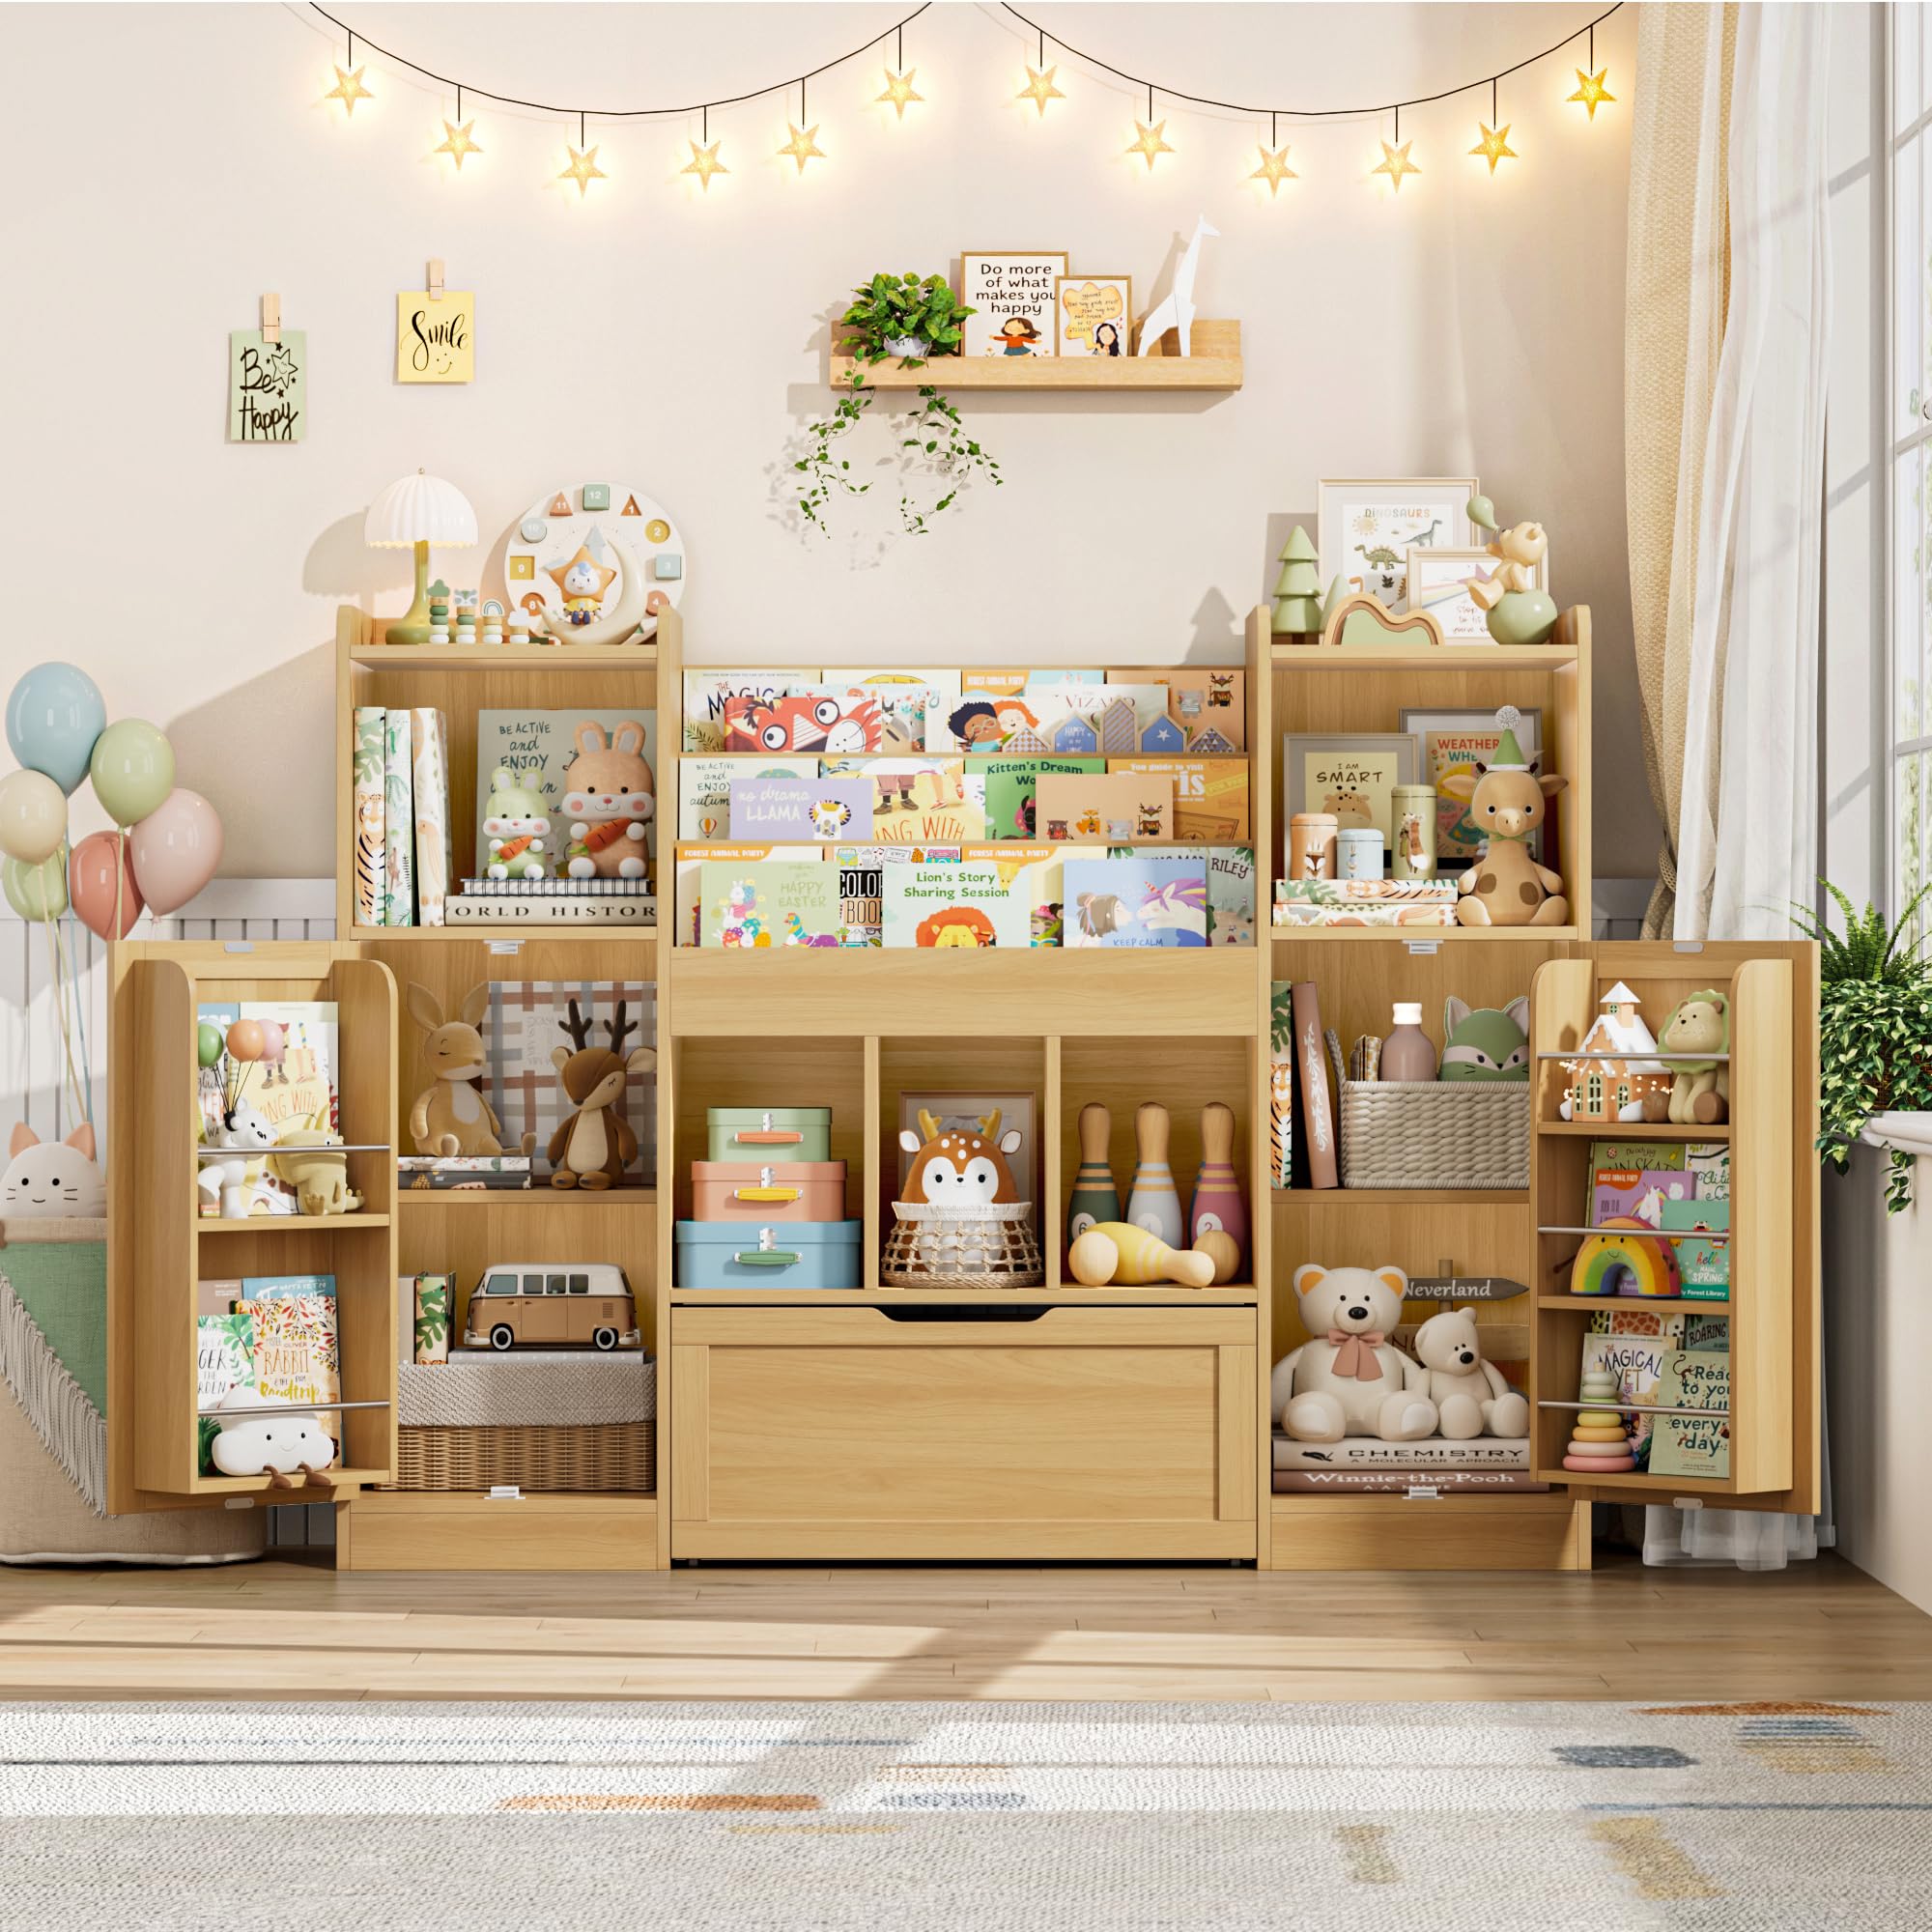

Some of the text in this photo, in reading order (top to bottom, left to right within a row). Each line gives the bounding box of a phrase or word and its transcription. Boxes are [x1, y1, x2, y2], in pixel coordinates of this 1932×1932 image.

[980, 264, 1052, 275] Do more
[985, 276, 1049, 288] of what
[976, 290, 1056, 302] makes you
[991, 302, 1042, 316] happy
[408, 310, 469, 372] Smile
[240, 346, 276, 394] Be
[238, 395, 298, 440] Happy
[588, 491, 602, 499] 12
[628, 504, 635, 514] 1
[653, 526, 662, 537] 2
[499, 721, 551, 734] BE ACTIVE
[510, 735, 539, 752] and
[1437, 739, 1499, 750] WEATHER
[500, 754, 549, 770] ENJOY
[987, 761, 1083, 775] Kitten's Dream
[1316, 772, 1383, 782] SMART
[760, 783, 810, 802] drama
[746, 806, 801, 820] LLAMA
[916, 871, 996, 884] Lion's Story
[781, 880, 824, 895] HAPPY
[903, 887, 1009, 900] Sharing Session
[779, 896, 827, 907] EASTER
[445, 907, 529, 917] ORLD
[1114, 938, 1163, 947] KEEP CALM
[1406, 1279, 1492, 1296] Neverland
[1689, 1322, 1726, 1346] ROARING
[264, 1348, 309, 1376] RABBIT
[1599, 1350, 1662, 1378] MAGICAL
[1614, 1367, 1643, 1391] YET
[1682, 1379, 1698, 1395] to
[1671, 1418, 1720, 1435] every
[1685, 1432, 1720, 1457] day
[1304, 1473, 1515, 1484] Winnie-the-Pooh
